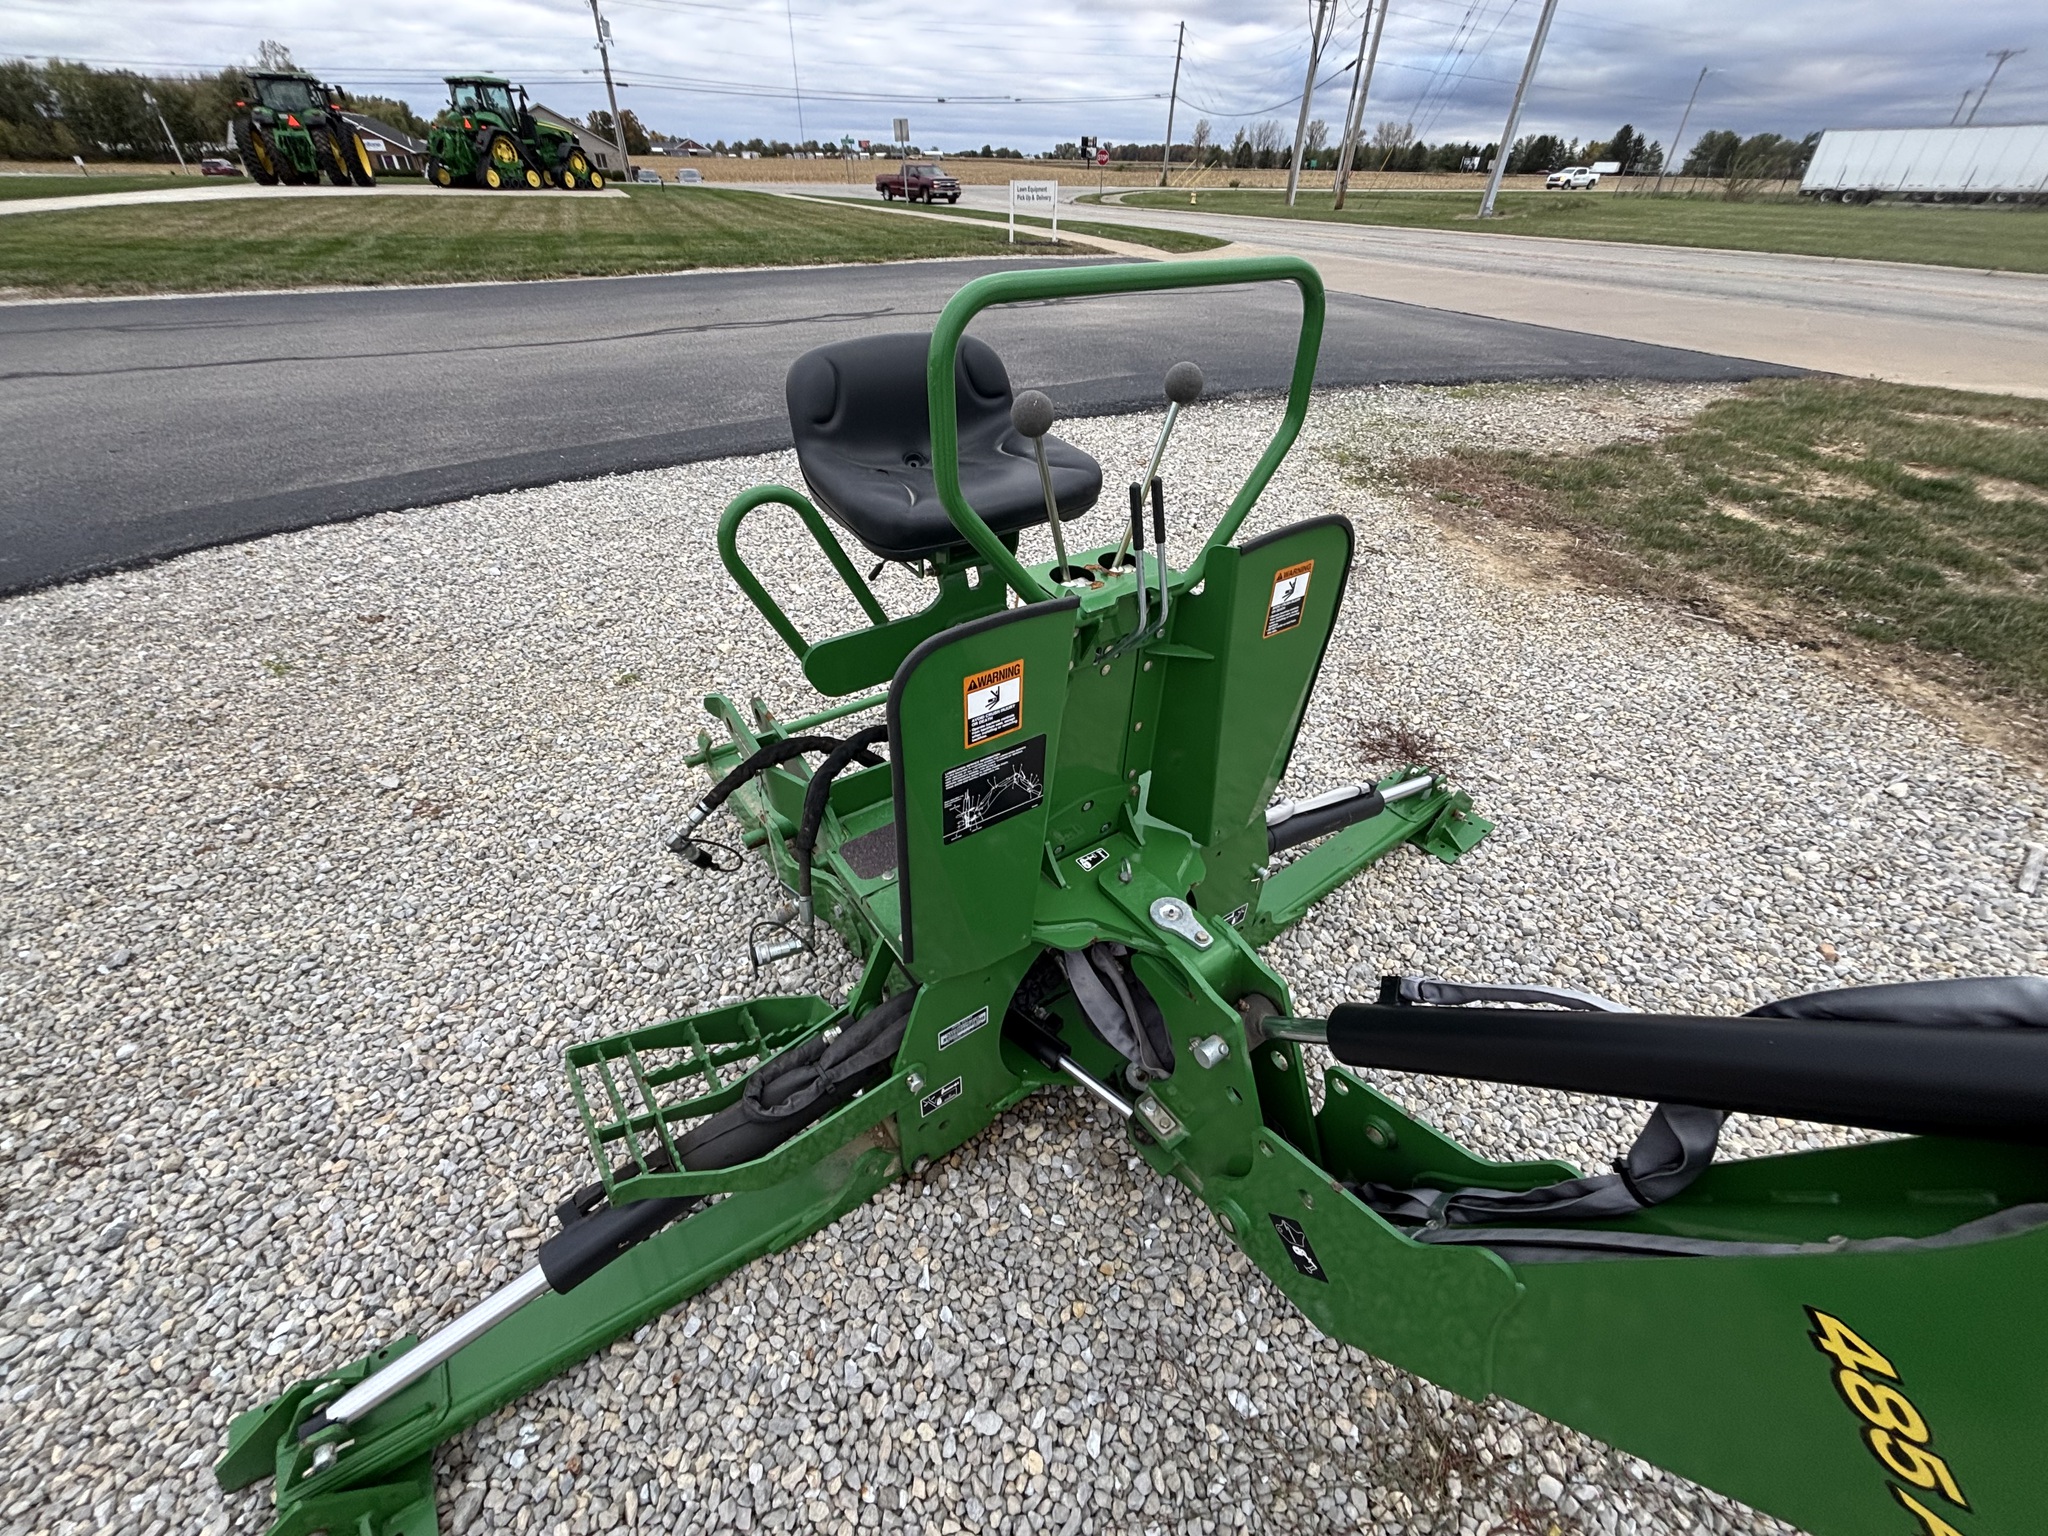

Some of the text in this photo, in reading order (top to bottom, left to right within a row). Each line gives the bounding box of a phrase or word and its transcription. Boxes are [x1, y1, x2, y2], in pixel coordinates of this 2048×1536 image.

[1036, 194, 1051, 202] Delivery
[1284, 563, 1312, 578] WARNING
[977, 664, 1020, 686] WARNING
